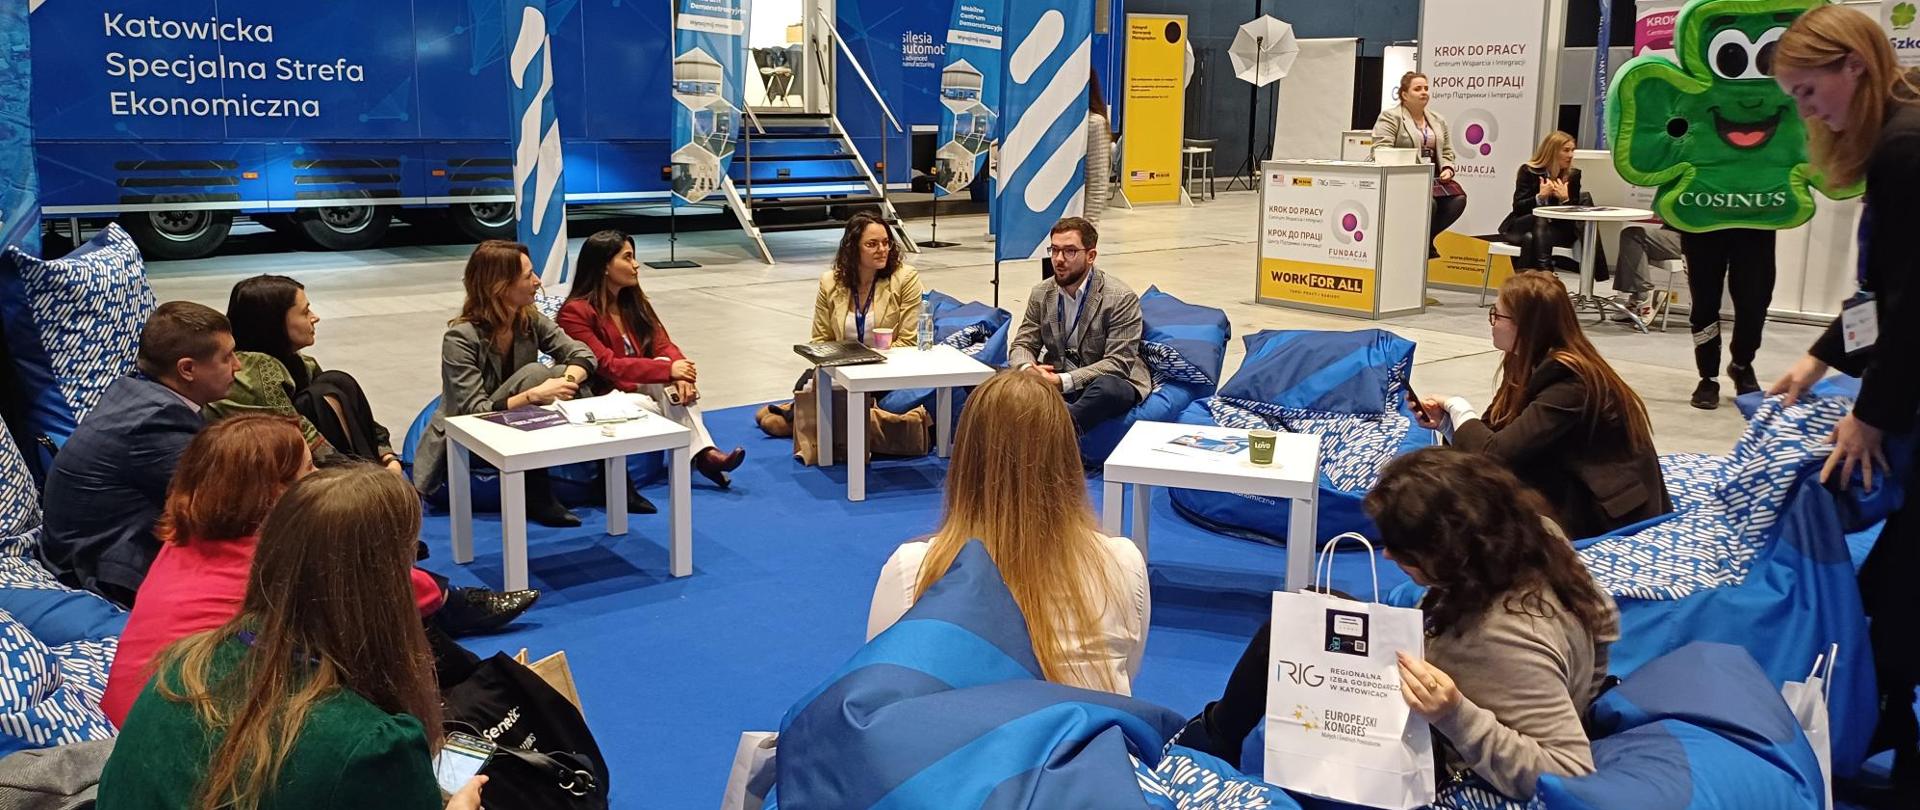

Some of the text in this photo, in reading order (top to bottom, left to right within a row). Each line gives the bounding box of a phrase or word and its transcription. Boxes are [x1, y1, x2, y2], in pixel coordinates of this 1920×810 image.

[103, 12, 273, 43] Katowicka
[1434, 44, 1526, 56] KROK DO PRACY
[106, 52, 365, 84] Specjalna Strefa
[1432, 76, 1525, 90] КРОК ДО ПРАЦІ
[110, 91, 320, 117] Ekonomiczna
[1454, 165, 1496, 174] UNDACJA
[1678, 191, 1786, 208] COSINUS
[1269, 205, 1324, 216] KROK DO PRACY
[1268, 229, 1287, 238] КРОК
[1288, 231, 1299, 240] ДО
[1328, 248, 1368, 258] FUNDACJA
[1271, 270, 1362, 292] WORK FOR ALL
[1330, 667, 1382, 681] REGIONALNA
[1329, 676, 1401, 692] IZBA GOSPODARCZ
[1324, 709, 1378, 728] EUROPEJSKI
[1323, 720, 1367, 738] KONGRES
